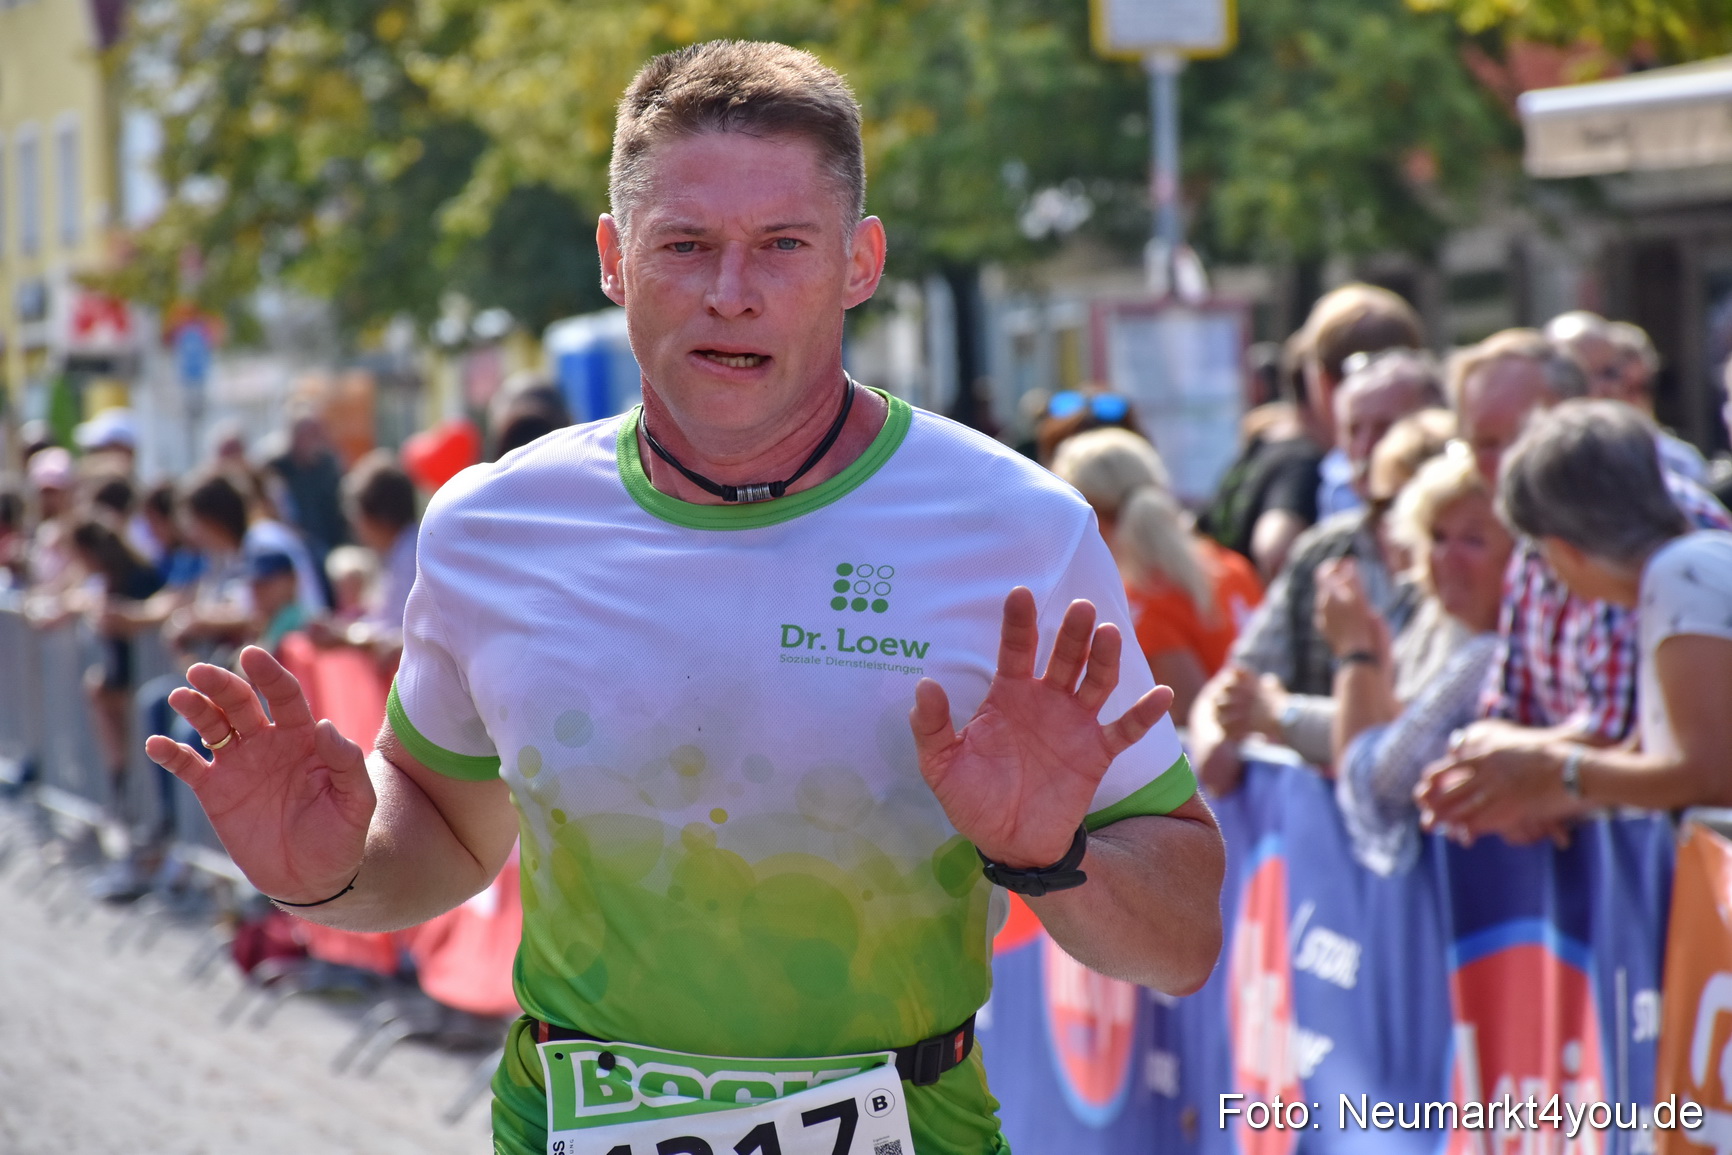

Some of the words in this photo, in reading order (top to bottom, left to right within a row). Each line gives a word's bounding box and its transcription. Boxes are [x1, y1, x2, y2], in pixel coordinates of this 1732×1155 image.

[780, 623, 827, 651] Dr.
[836, 627, 931, 660] Loew
[779, 653, 822, 665] Soziale
[825, 655, 925, 676] Dienstleistungen
[872, 1095, 888, 1113] B
